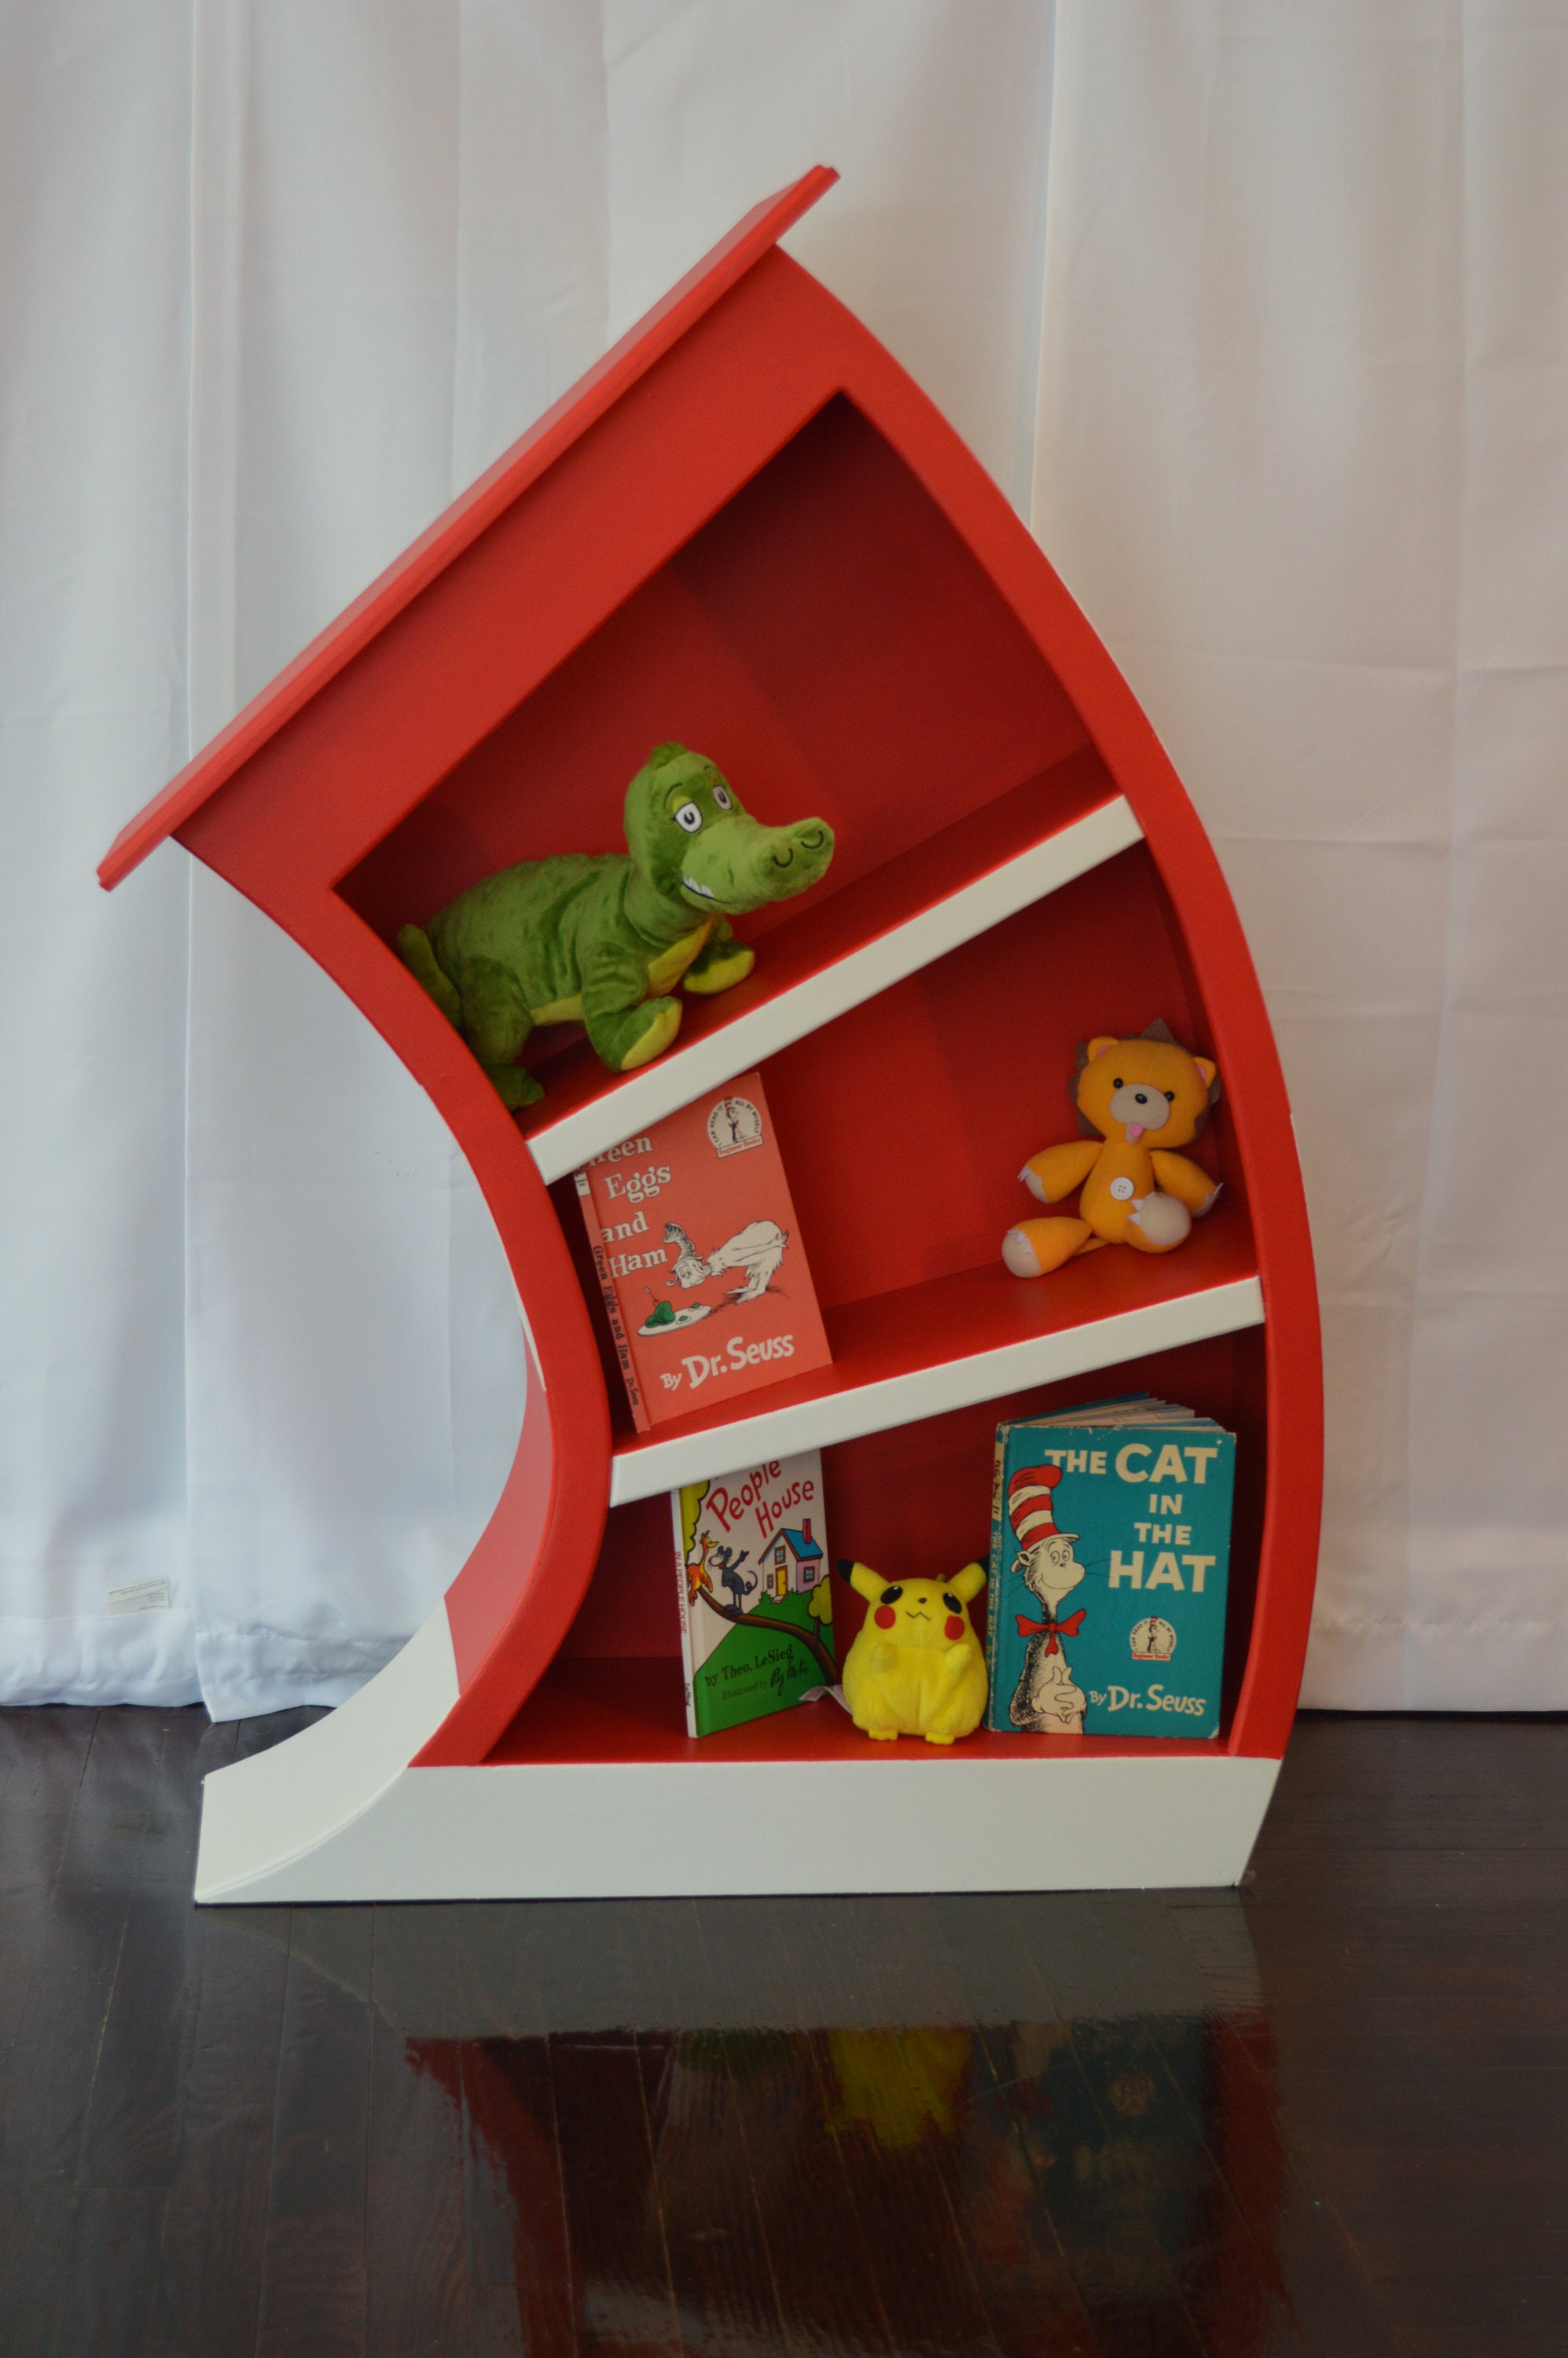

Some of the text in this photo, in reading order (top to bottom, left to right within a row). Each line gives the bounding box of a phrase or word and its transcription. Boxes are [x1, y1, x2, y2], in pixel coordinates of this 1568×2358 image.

[603, 1166, 672, 1203] Eggs
[600, 1210, 650, 1243] and
[593, 1245, 608, 1280] Green
[608, 1248, 669, 1279] Ham
[611, 1318, 626, 1340] and
[617, 1344, 630, 1370] Ham
[659, 1335, 795, 1390] By Dr. Seuss
[1045, 1443, 1218, 1484] THE CAT
[706, 1460, 782, 1533] People
[755, 1480, 815, 1539] House
[1149, 1493, 1183, 1515] IN
[1133, 1522, 1192, 1545] THE
[1108, 1550, 1217, 1592] HAT
[721, 1664, 753, 1680] Theo.
[754, 1644, 794, 1669] LeSieg
[1089, 1684, 1206, 1717] By Dr. Seuss
